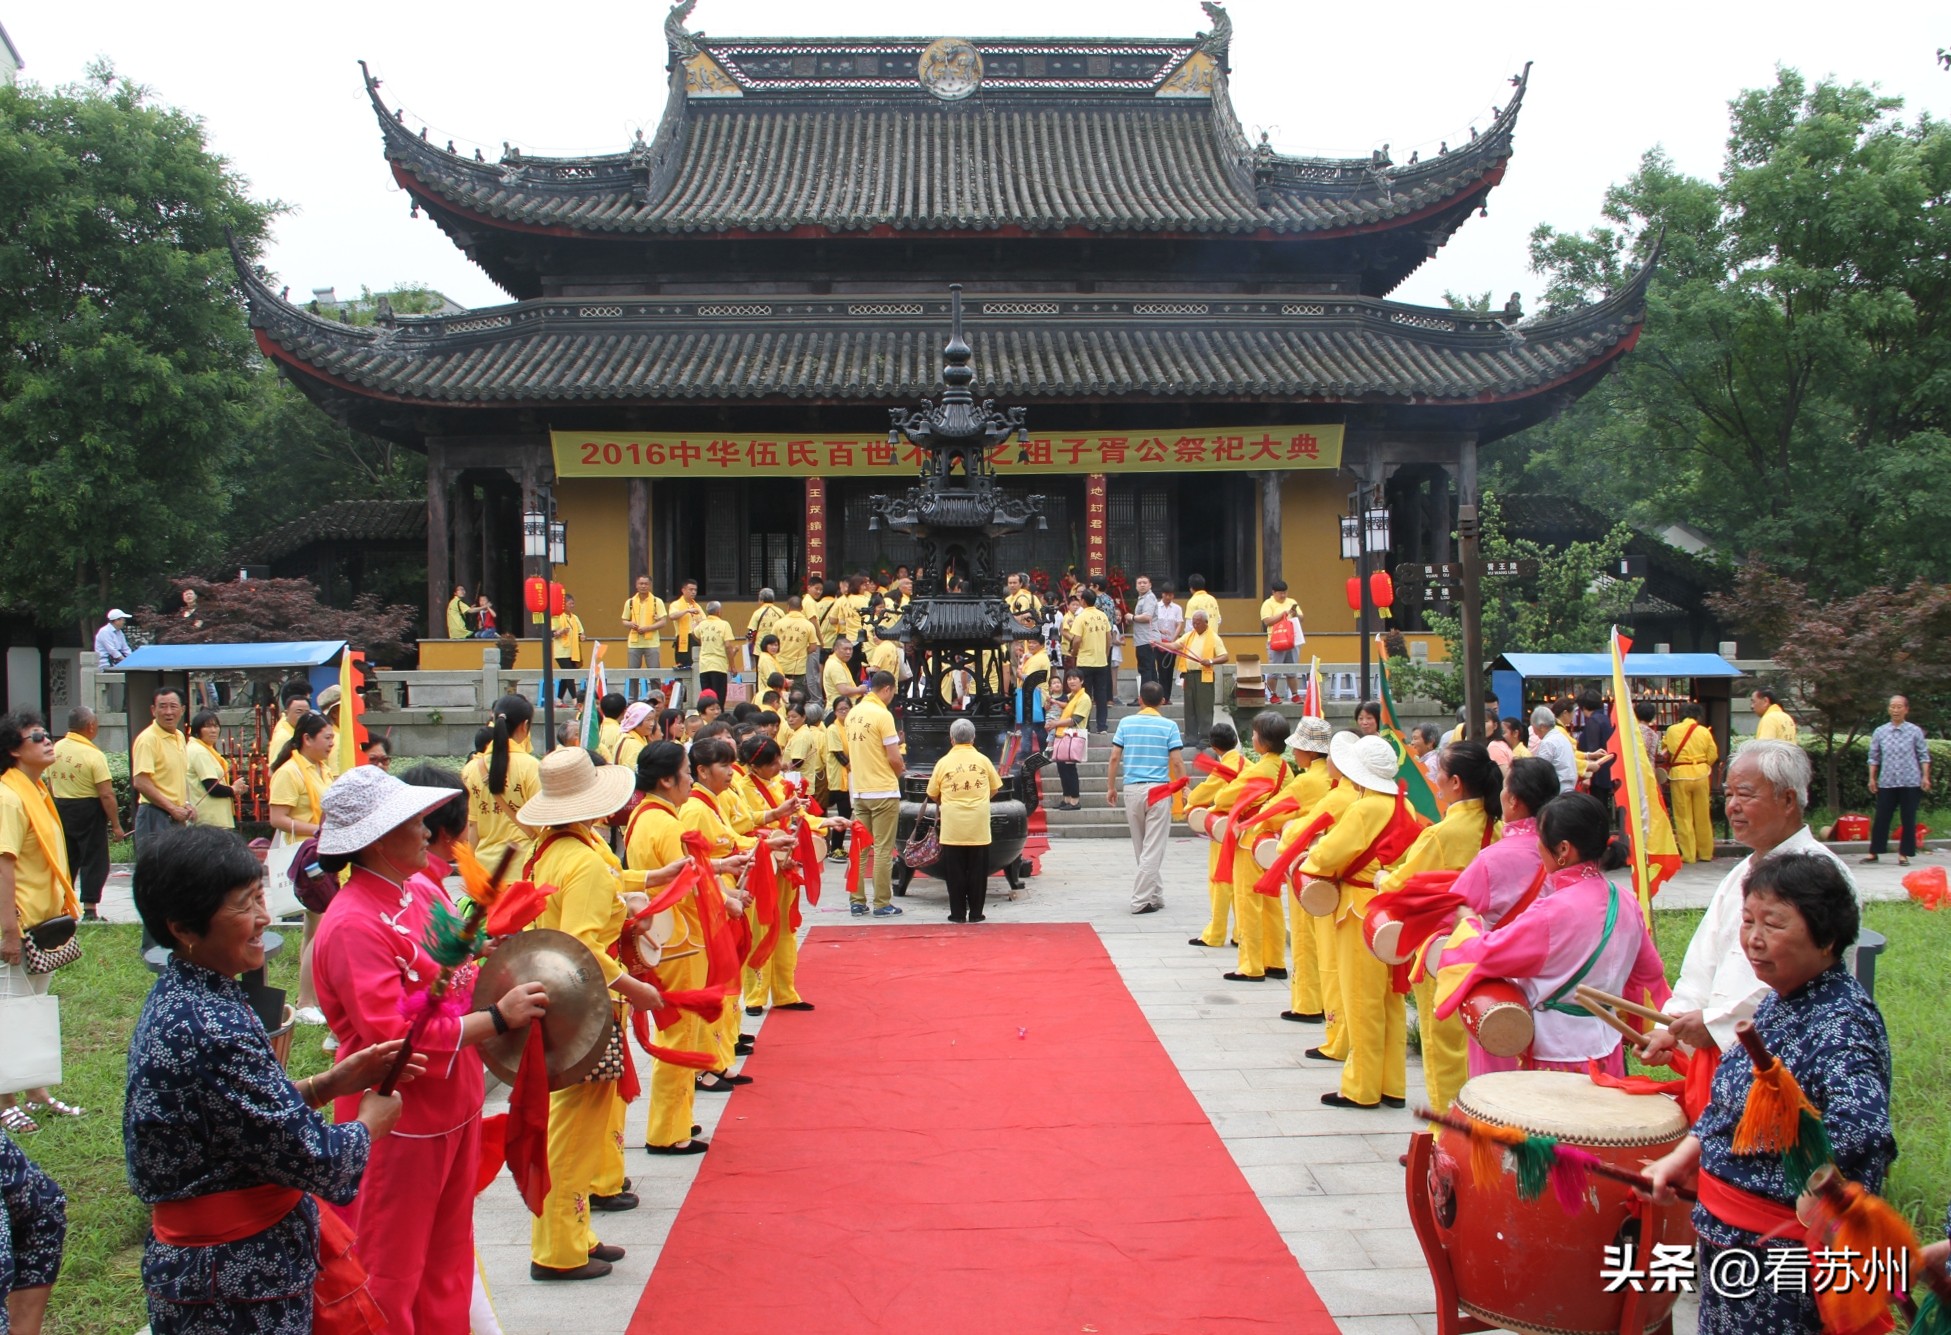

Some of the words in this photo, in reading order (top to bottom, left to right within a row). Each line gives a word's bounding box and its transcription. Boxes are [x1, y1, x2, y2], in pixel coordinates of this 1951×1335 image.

[580, 433, 1320, 468] 2016中华伍氏百世不之祖子胥公祭祀大典
